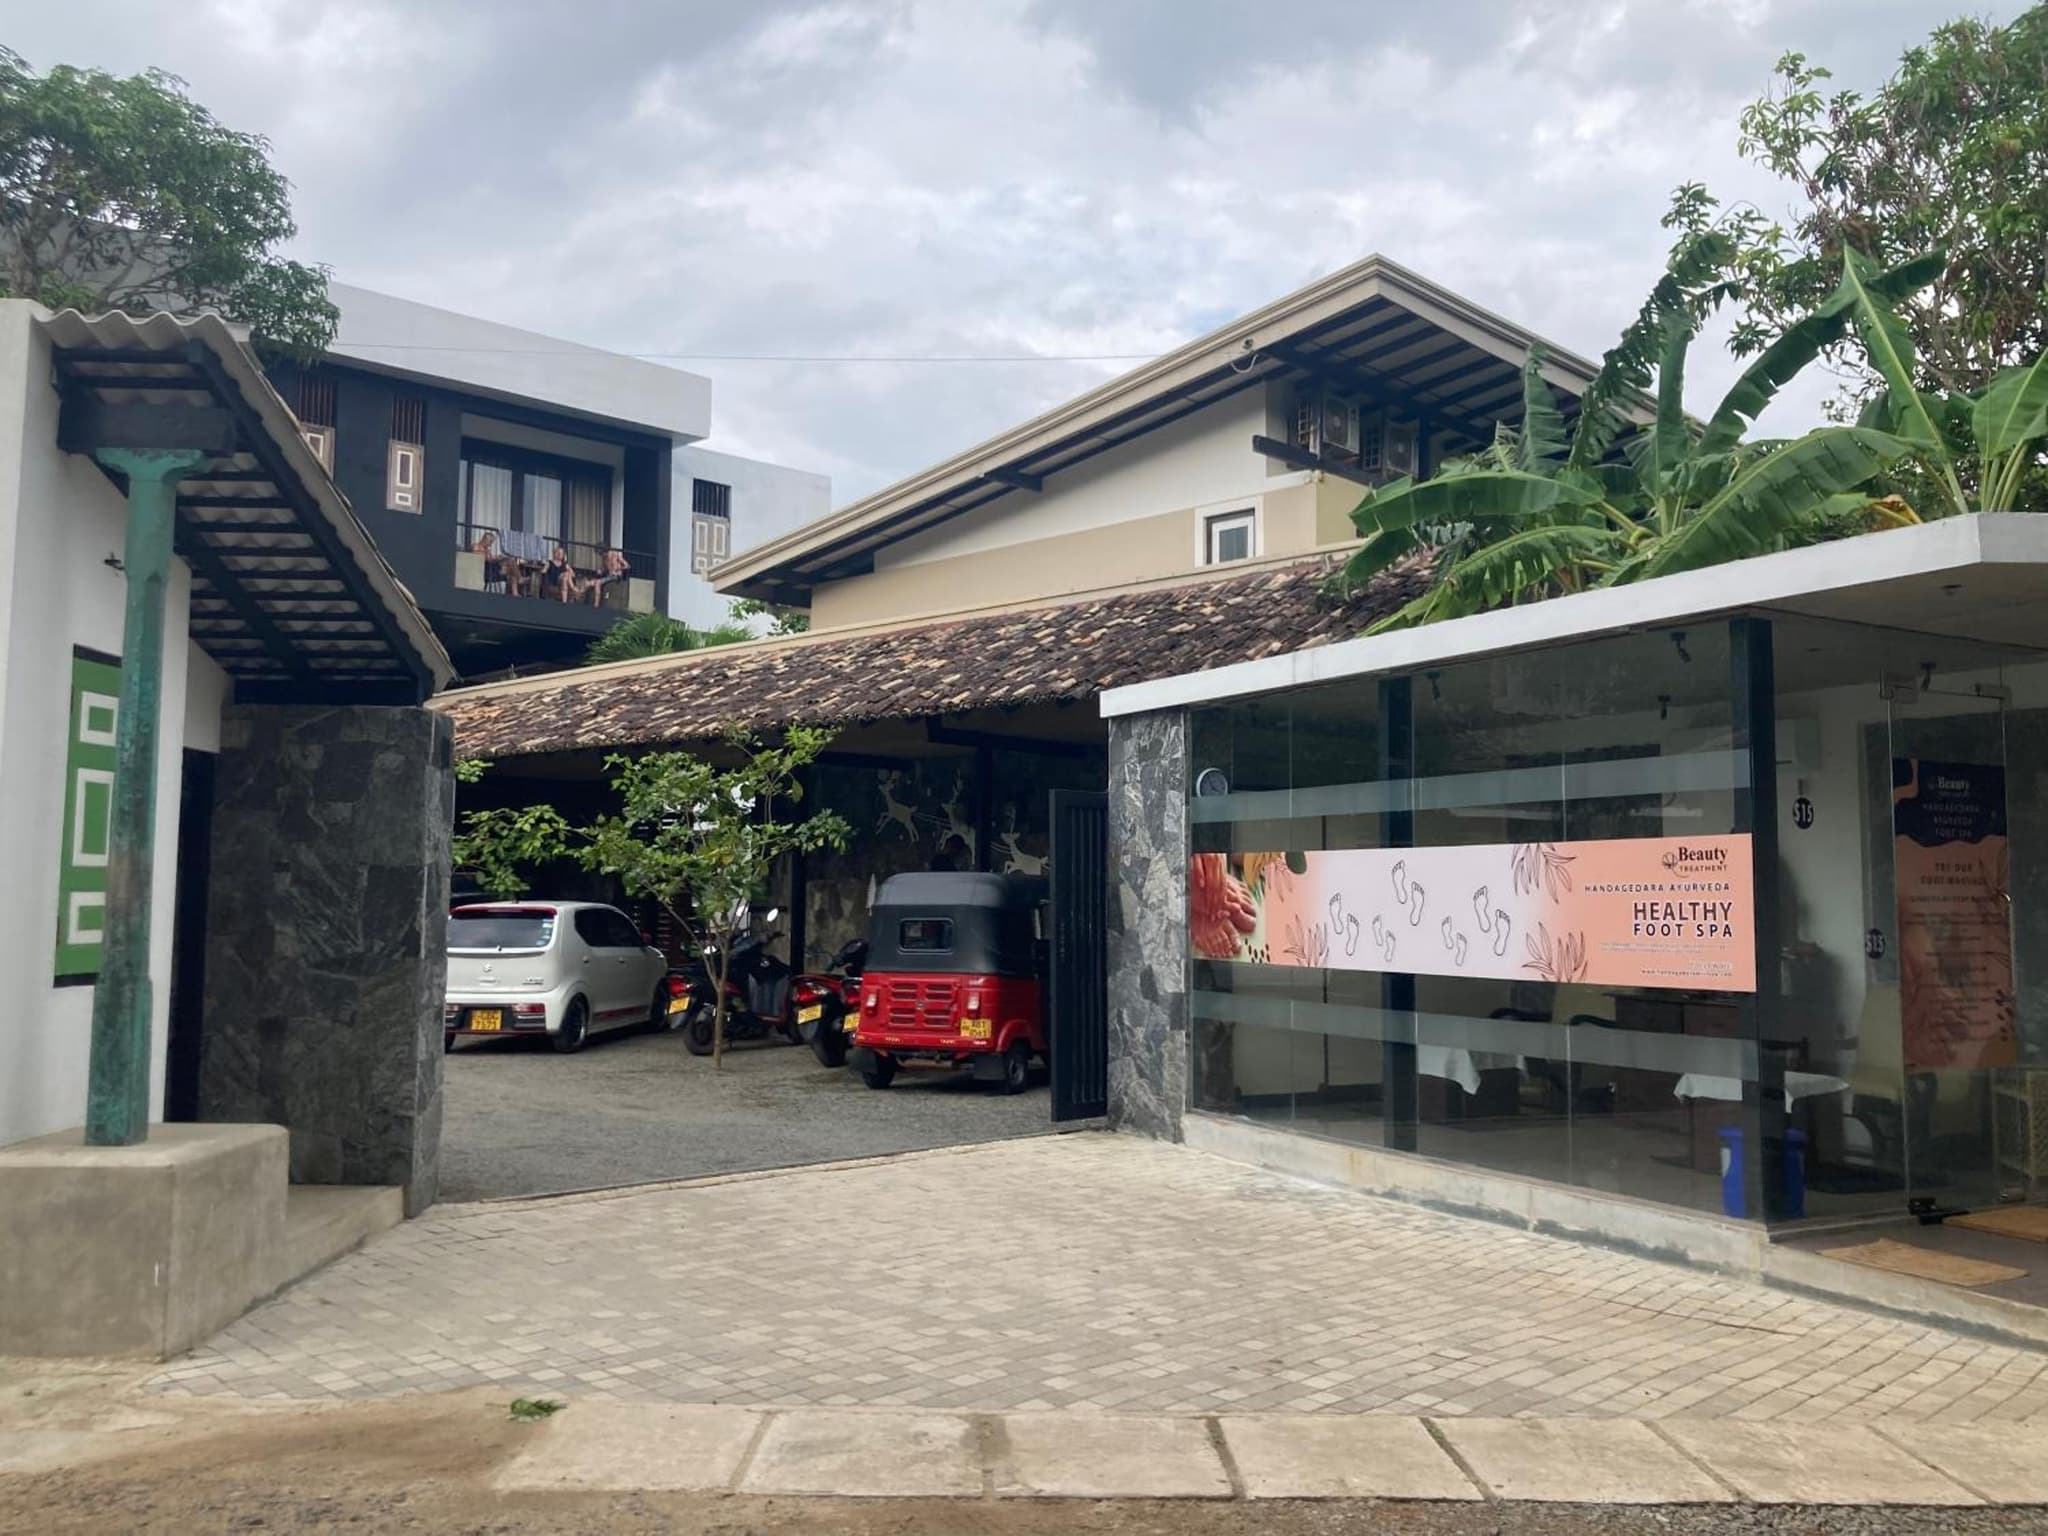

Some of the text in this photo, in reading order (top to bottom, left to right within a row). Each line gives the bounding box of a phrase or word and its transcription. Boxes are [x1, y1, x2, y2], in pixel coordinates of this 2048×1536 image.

[1679, 846, 1728, 865] Beauty
[1680, 864, 1727, 873] TREATMENT
[1584, 882, 1730, 893] HANDAGEDARA AYURVEDA
[1633, 901, 1732, 921] HEALTHY
[1633, 923, 1732, 938] FOOT SPA
